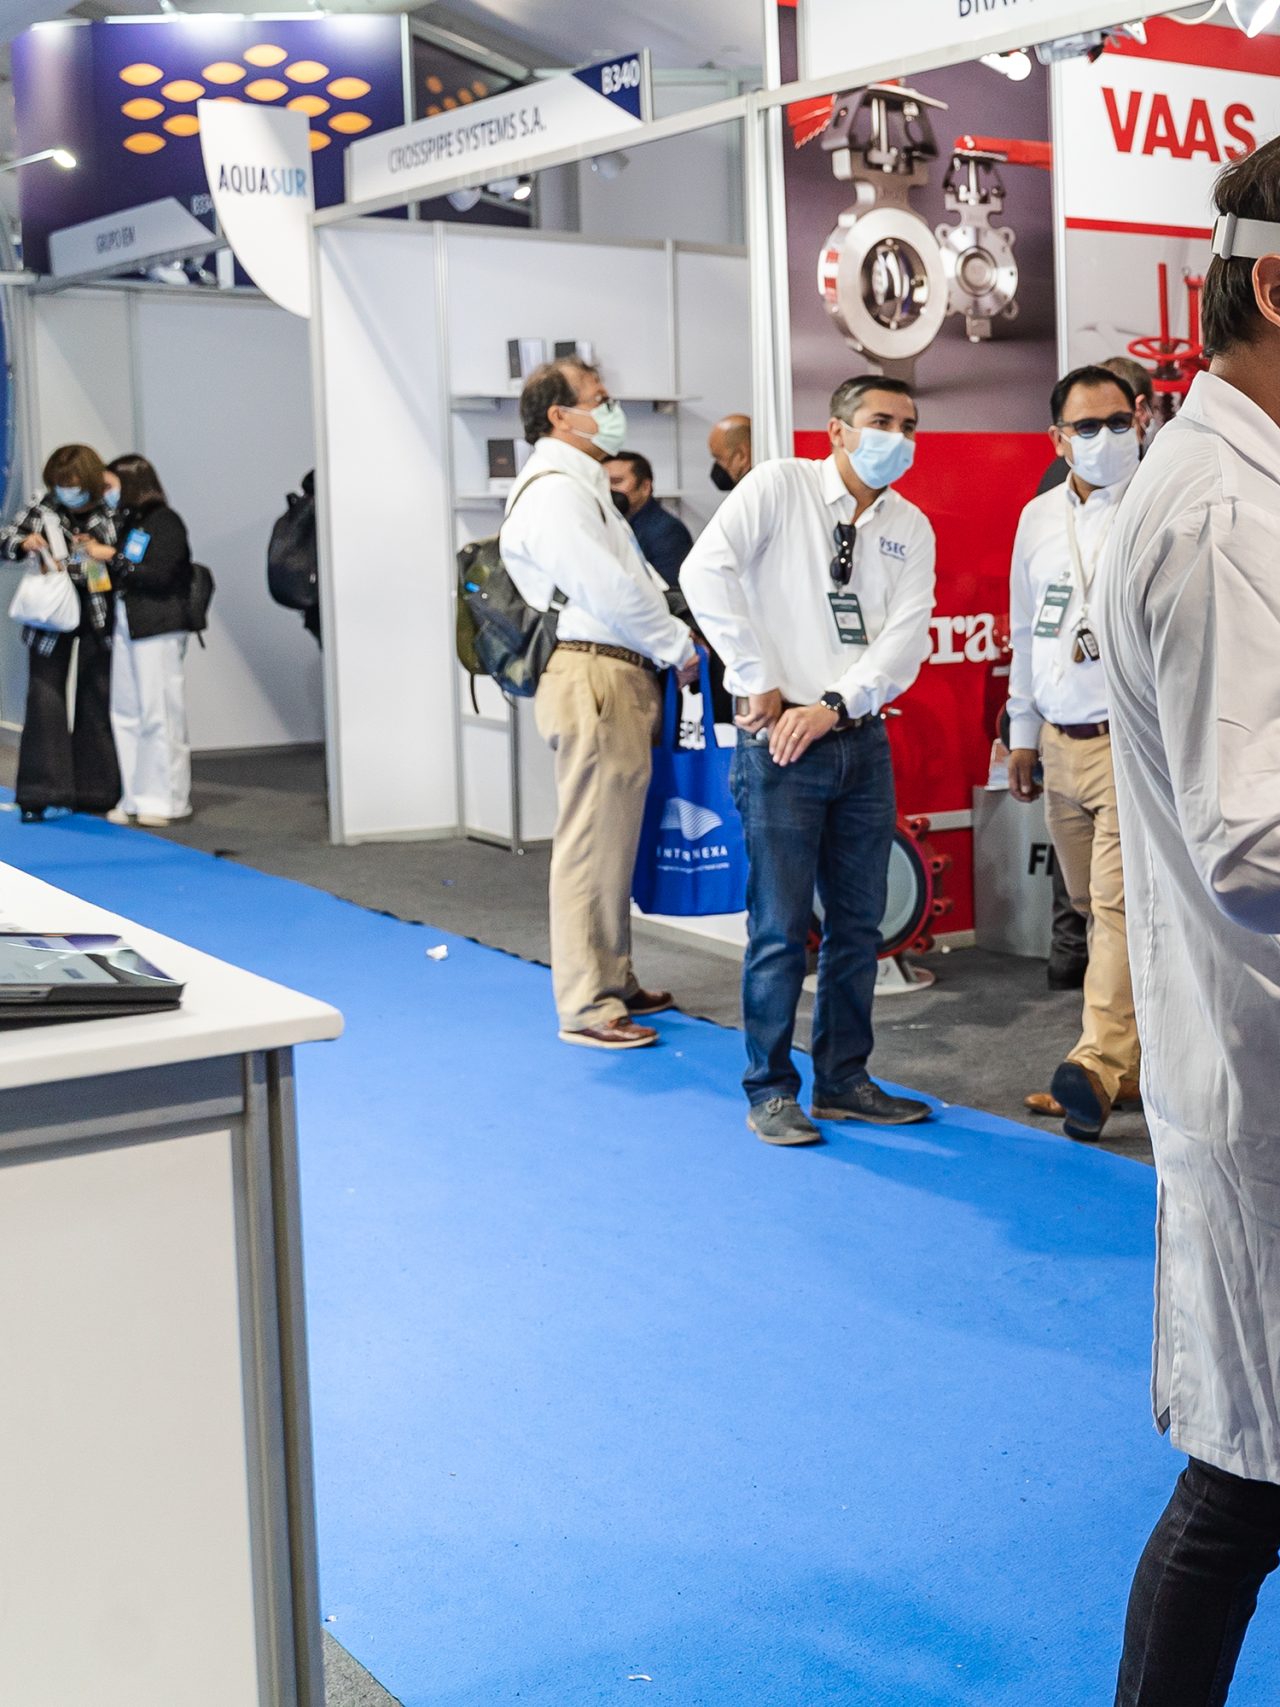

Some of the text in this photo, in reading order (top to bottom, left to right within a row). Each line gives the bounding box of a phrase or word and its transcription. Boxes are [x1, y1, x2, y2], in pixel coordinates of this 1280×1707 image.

[601, 59, 641, 96] B340
[455, 112, 518, 154] SYSTEMS
[519, 106, 547, 137] S.A.
[1101, 86, 1256, 162] VAAS
[218, 164, 308, 197] AQUASUR
